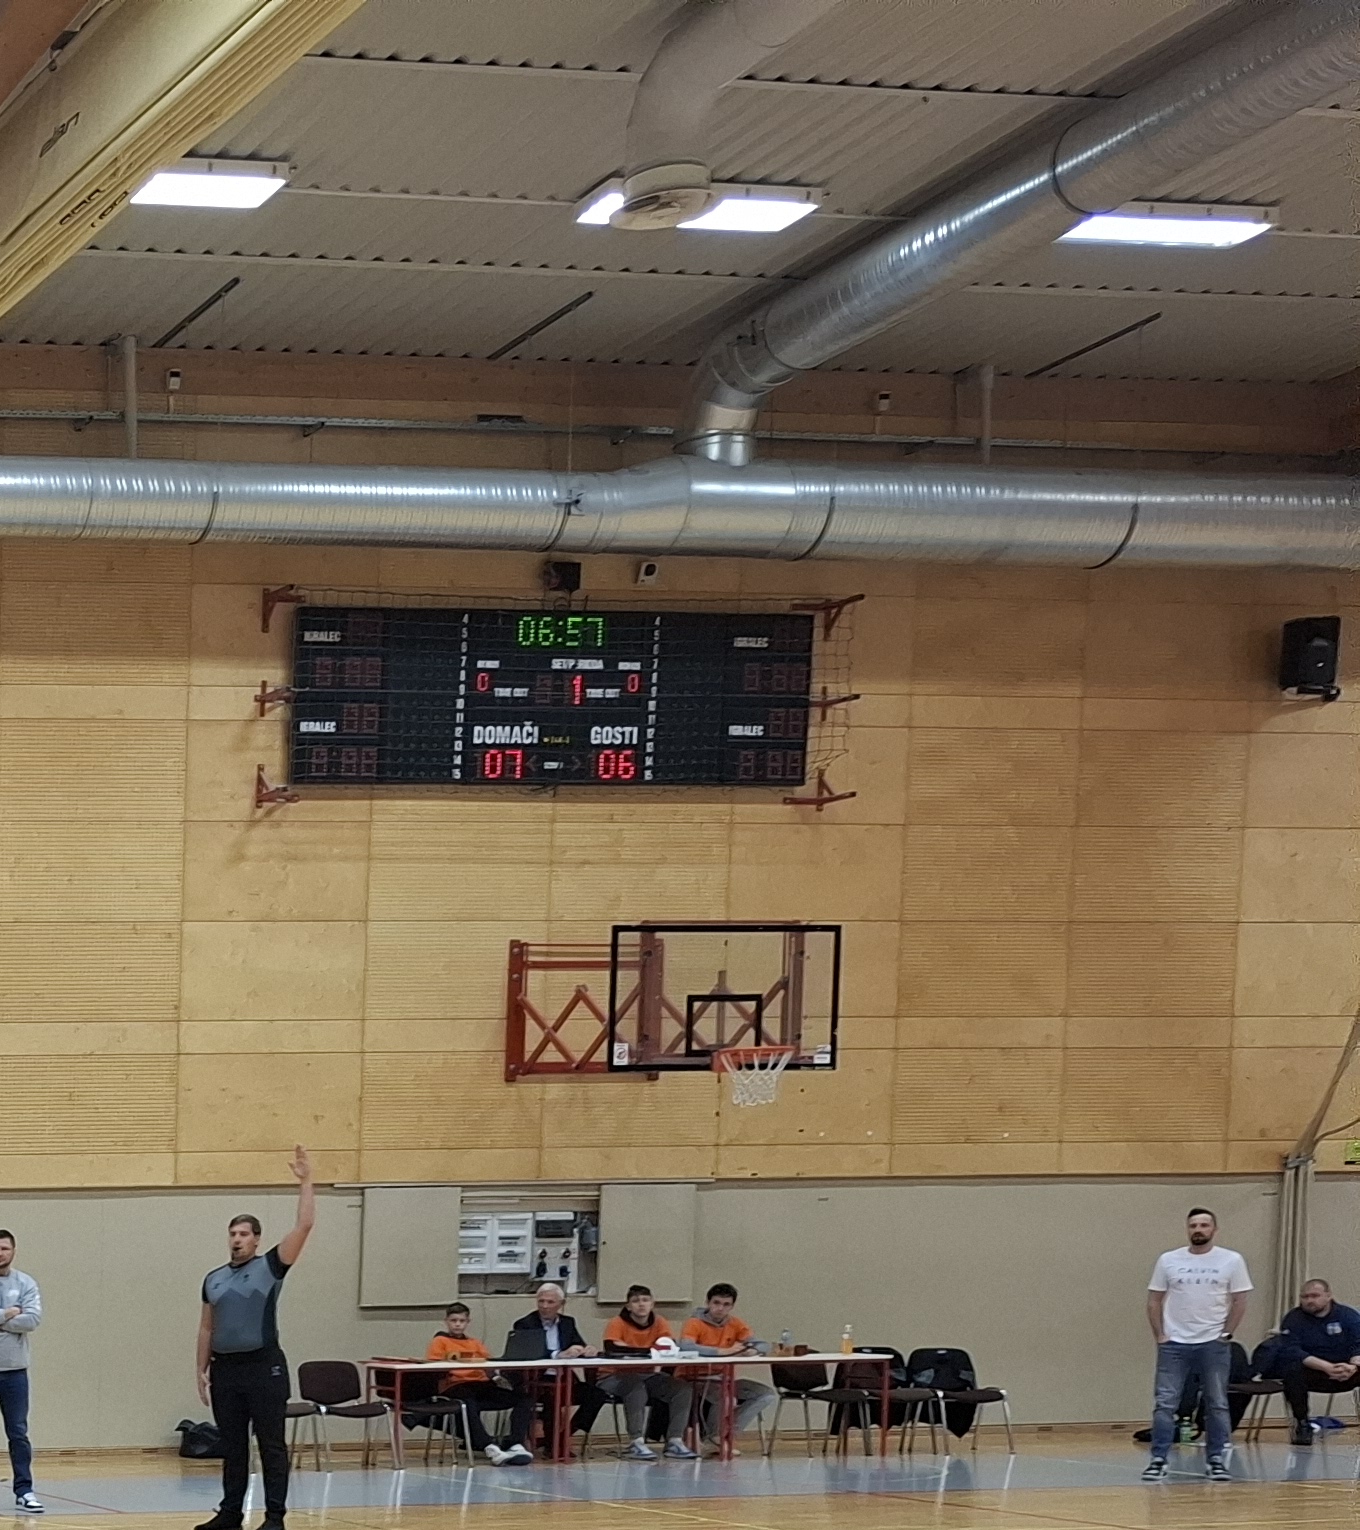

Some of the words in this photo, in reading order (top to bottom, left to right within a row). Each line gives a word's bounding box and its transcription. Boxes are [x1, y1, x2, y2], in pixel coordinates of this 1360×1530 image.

[518, 616, 605, 647] 06:57
[476, 672, 489, 692] 0
[572, 674, 582, 705] 1
[627, 673, 640, 693] 0
[472, 720, 539, 744] DOMAČI
[590, 726, 638, 745] GOSTI
[484, 750, 523, 779] 07
[598, 750, 636, 779] 06
